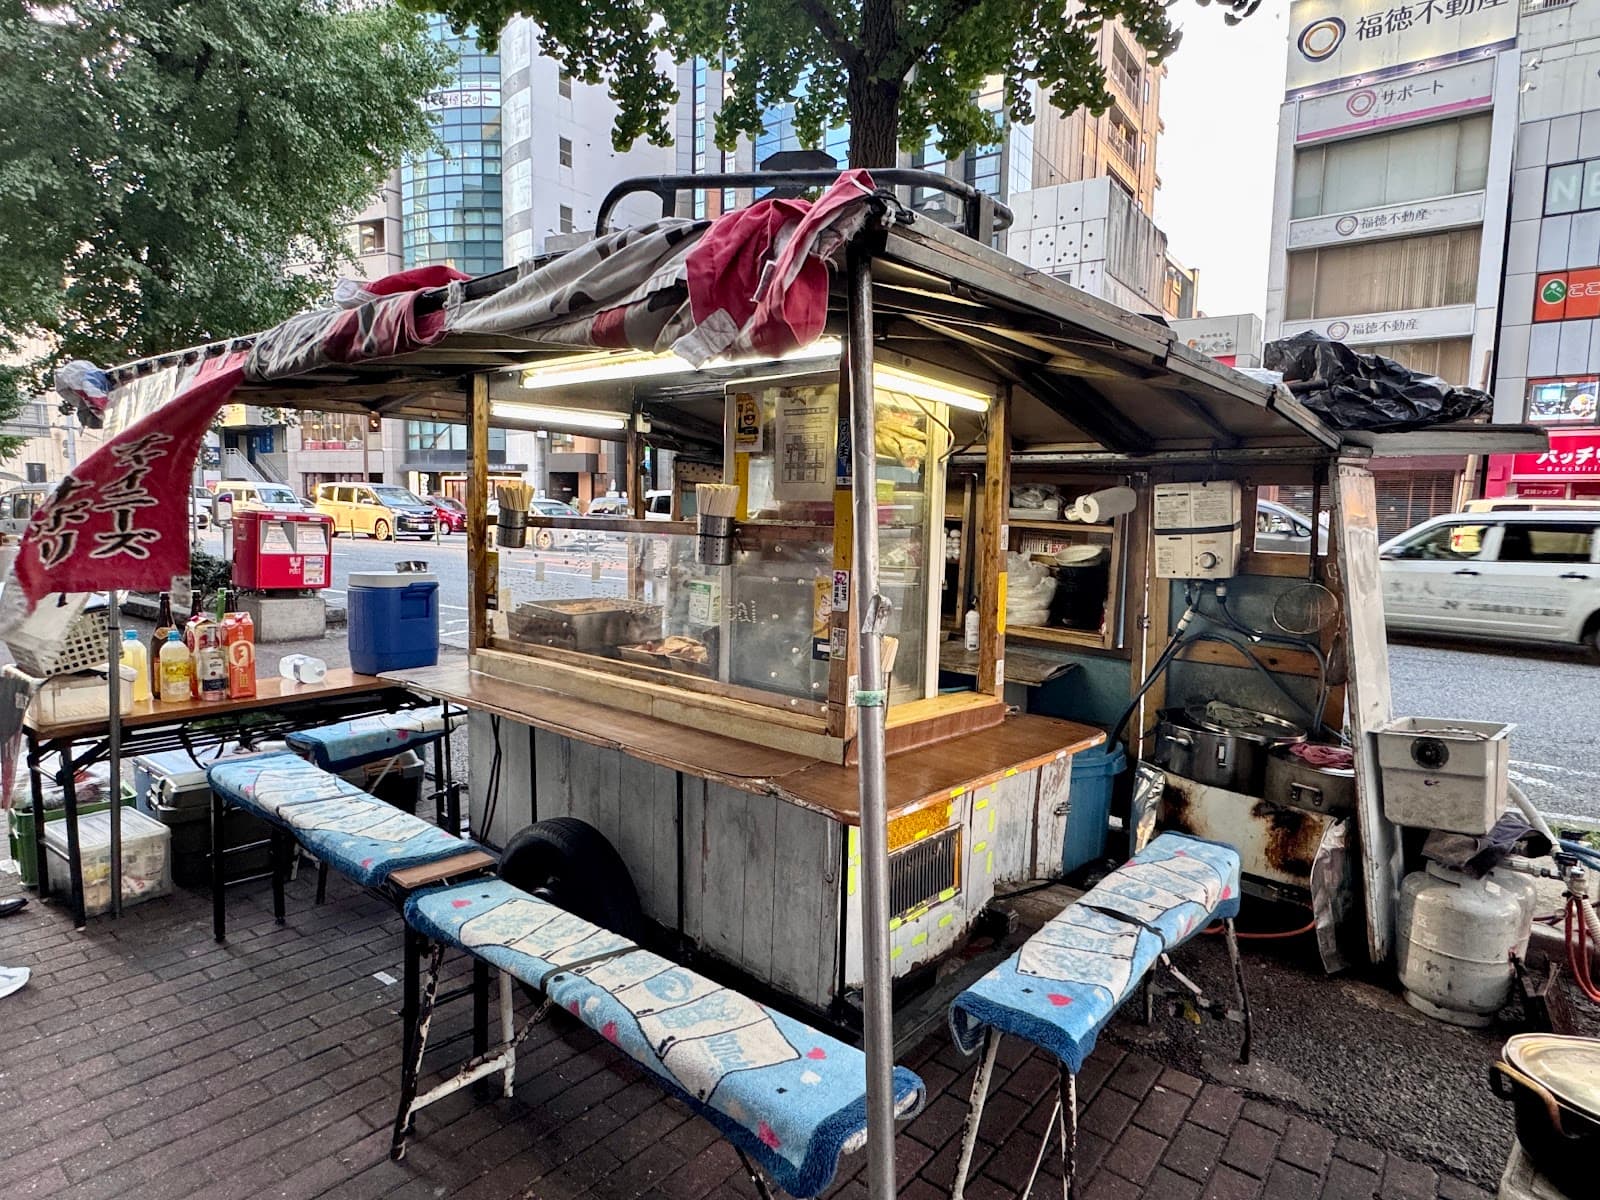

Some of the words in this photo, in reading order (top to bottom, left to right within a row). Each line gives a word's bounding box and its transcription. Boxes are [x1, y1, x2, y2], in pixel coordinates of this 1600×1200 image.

[1360, 208, 1429, 230] 福徳不動産
[1352, 318, 1418, 336] 福徳不動産
